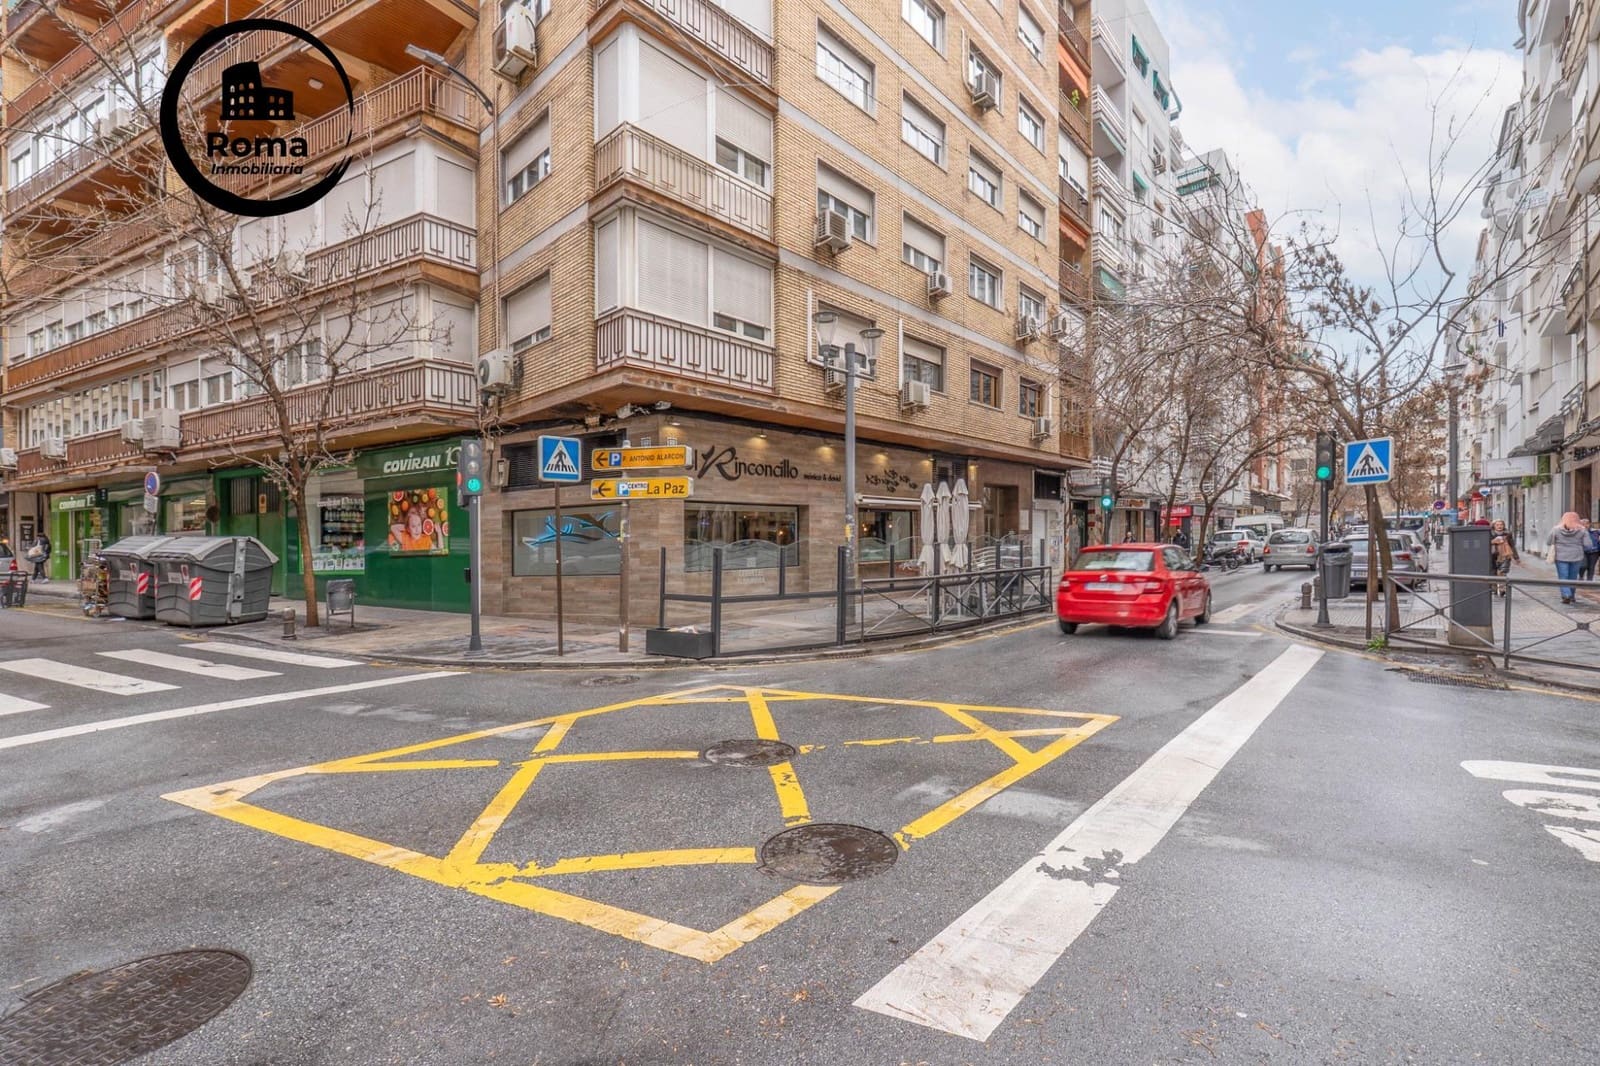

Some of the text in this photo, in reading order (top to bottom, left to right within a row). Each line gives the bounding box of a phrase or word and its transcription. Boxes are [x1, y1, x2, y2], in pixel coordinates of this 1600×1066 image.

[610, 453, 621, 466] P
[629, 454, 655, 463] ANTONIO
[697, 445, 799, 481] Rinconcillo
[647, 484, 660, 494] La
[664, 483, 685, 494] Paz
